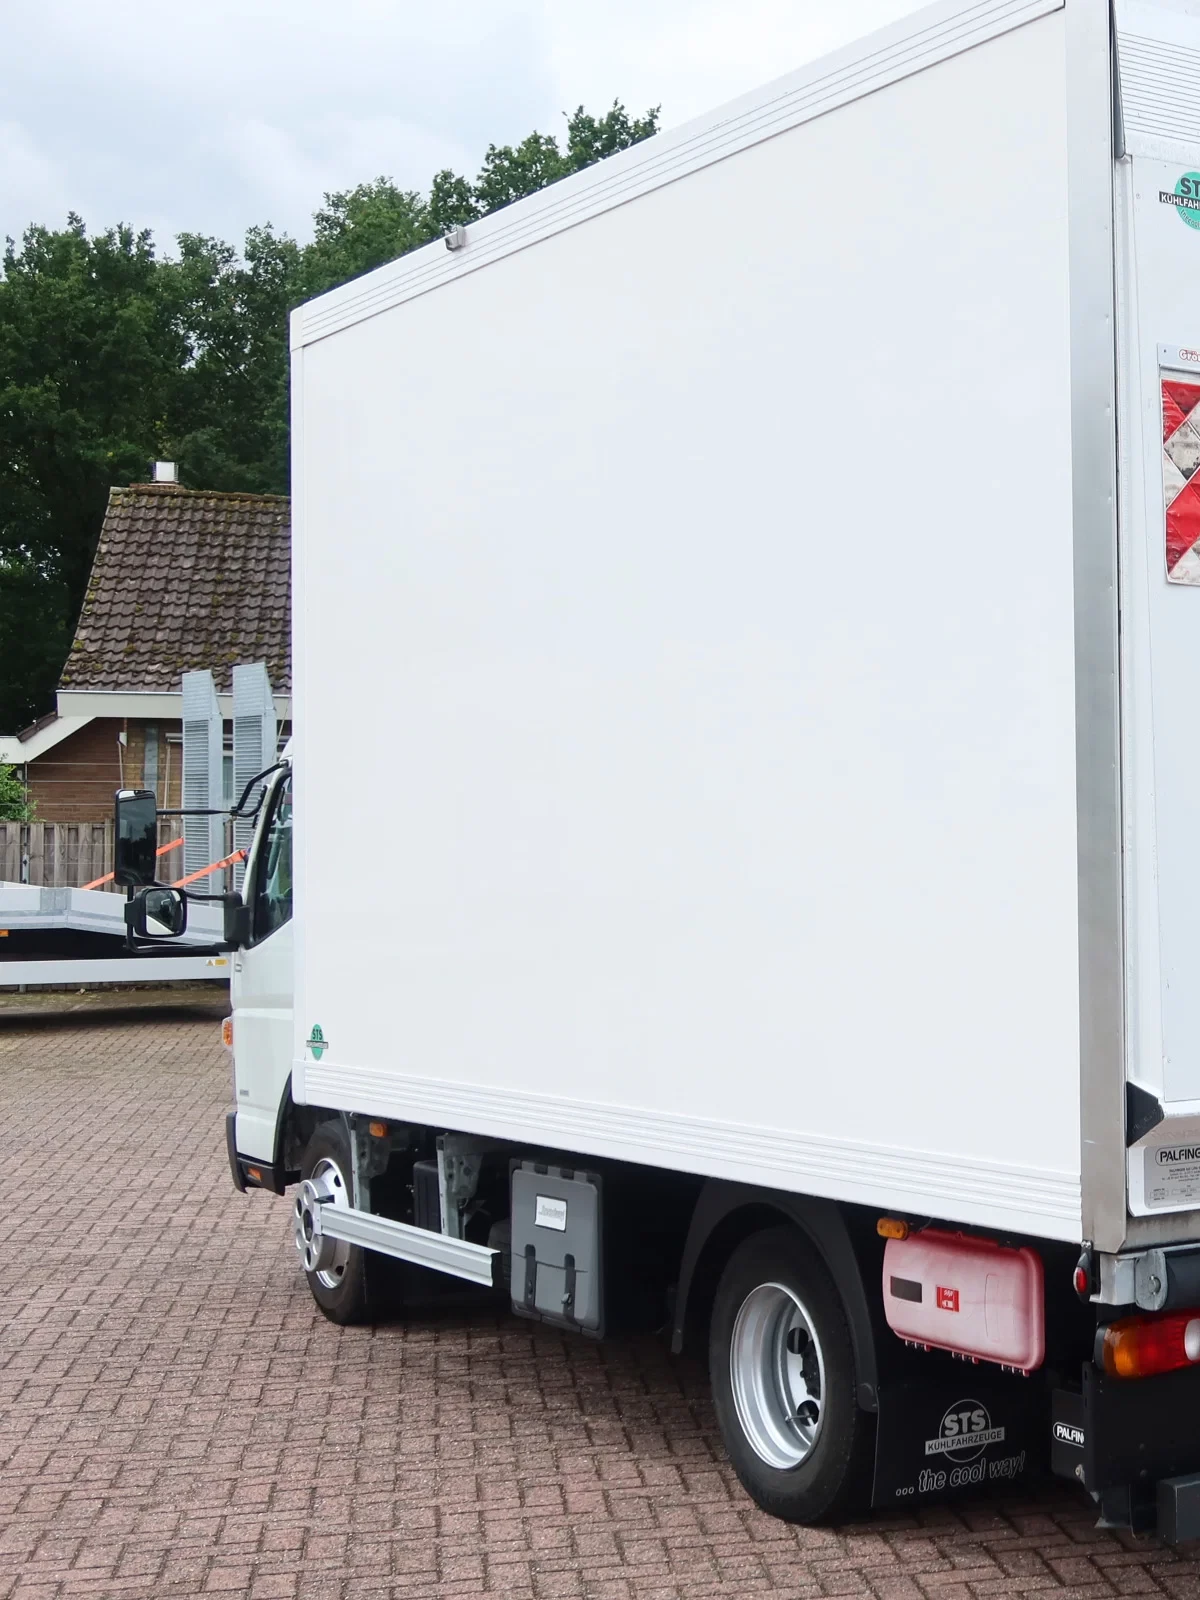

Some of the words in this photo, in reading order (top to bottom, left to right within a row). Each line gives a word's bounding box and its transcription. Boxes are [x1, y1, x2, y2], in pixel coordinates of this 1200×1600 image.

[312, 1028, 323, 1040] STS
[944, 1409, 986, 1436] STS
[928, 1431, 1003, 1452] KÜHLFAHRZEUGE
[918, 1469, 946, 1492] the
[950, 1458, 985, 1486] cool
[990, 1450, 1025, 1479] way!
